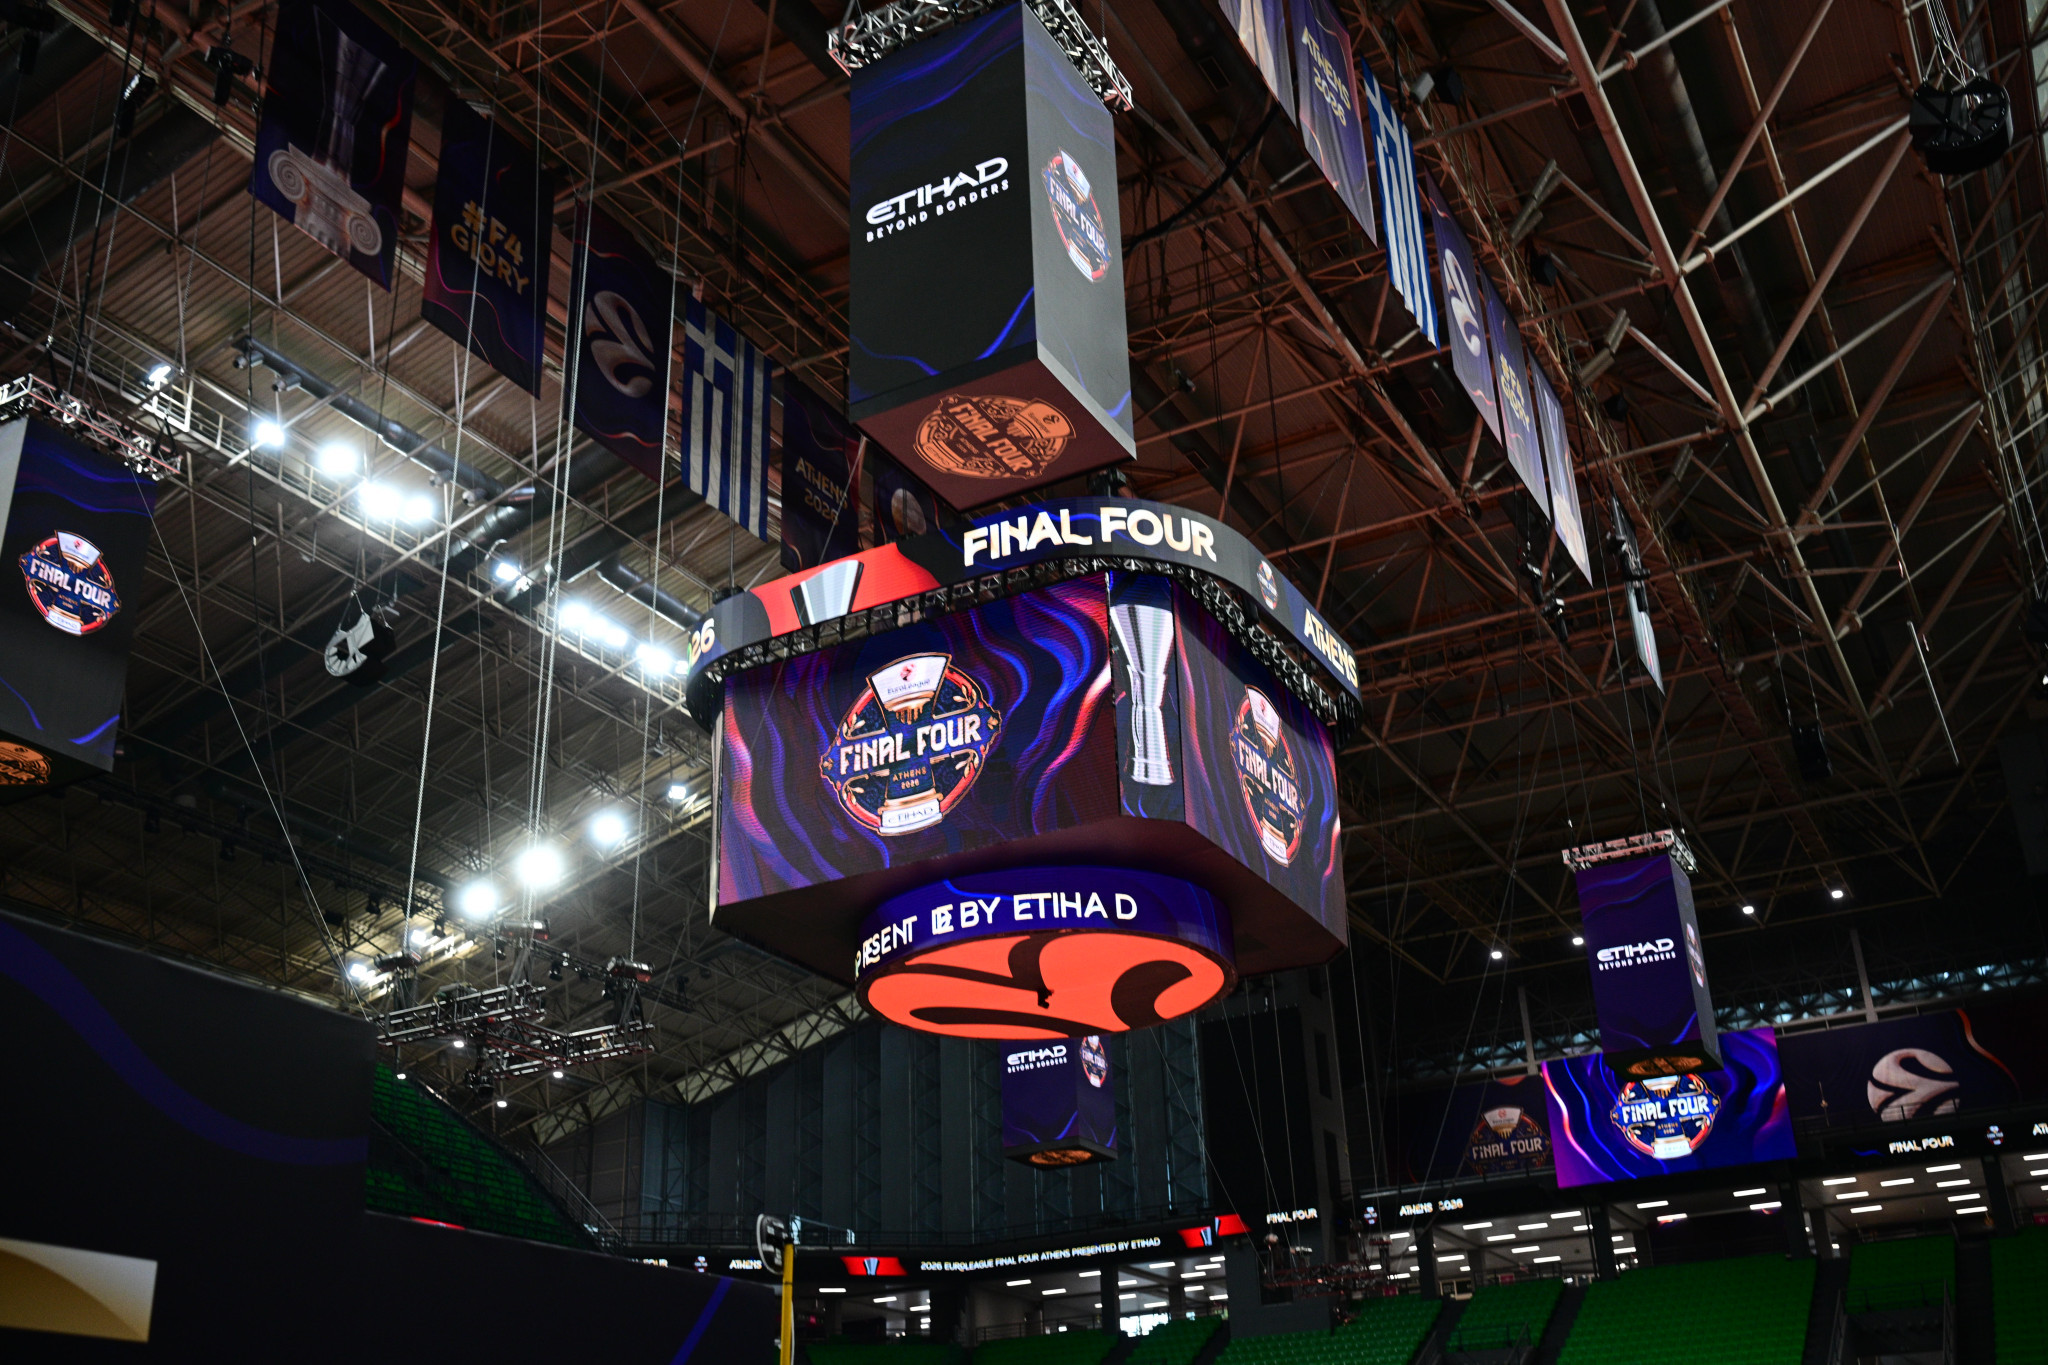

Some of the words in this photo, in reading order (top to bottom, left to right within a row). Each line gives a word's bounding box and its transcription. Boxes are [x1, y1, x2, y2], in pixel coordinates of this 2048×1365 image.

[1302, 25, 1351, 110] ATHENS
[1313, 67, 1347, 127] 2026
[866, 157, 1009, 225] ETIHAD
[866, 211, 928, 243] BEYOND
[936, 179, 1009, 216] BORDERS
[1049, 175, 1080, 226] FINAL
[1080, 211, 1106, 257] FOUR
[450, 223, 530, 296] GLORY
[462, 200, 524, 266] #F4
[948, 402, 1000, 442] FINAL
[986, 437, 1033, 473] FOUR
[795, 457, 849, 510] ATHENS
[963, 508, 1093, 568] FINAL
[1100, 506, 1218, 563] FOUR
[30, 558, 72, 592] FINAL
[74, 579, 112, 610] FOUR
[1303, 608, 1359, 689] ATHENS
[839, 732, 911, 776] FINAL
[917, 713, 982, 757] FOUR
[892, 766, 927, 783] ATHENS
[1238, 738, 1272, 790] FINAL
[1271, 767, 1300, 814] FOUR
[960, 896, 1001, 929] BY
[1597, 938, 1675, 962] ETIHAD
[1598, 958, 1633, 972] BEYOND
[1636, 950, 1677, 965] BORDERS
[1007, 1045, 1067, 1066] ETIHAD
[1621, 1101, 1667, 1124] FINAL
[1668, 1095, 1710, 1118] FOUR
[1472, 1142, 1508, 1161] FINAL
[1510, 1137, 1543, 1155] FOUR
[1888, 1139, 1922, 1154] FINAL
[1921, 1135, 1955, 1149] FOUR
[1266, 1209, 1292, 1224] FINAL
[1292, 1207, 1318, 1221] FOUR
[1399, 1202, 1433, 1217] ATHENS
[728, 1259, 763, 1270] ATHENS
[920, 1260, 943, 1271] 2026
[944, 1258, 994, 1272] EUROLEAGUE
[995, 1255, 1017, 1267] FINAL
[1018, 1252, 1040, 1264] FOUR
[1040, 1248, 1071, 1261] ATHENS
[1071, 1242, 1117, 1257] PRESENTED
[1117, 1240, 1130, 1252] BY
[1130, 1236, 1161, 1250] ETIHAD
